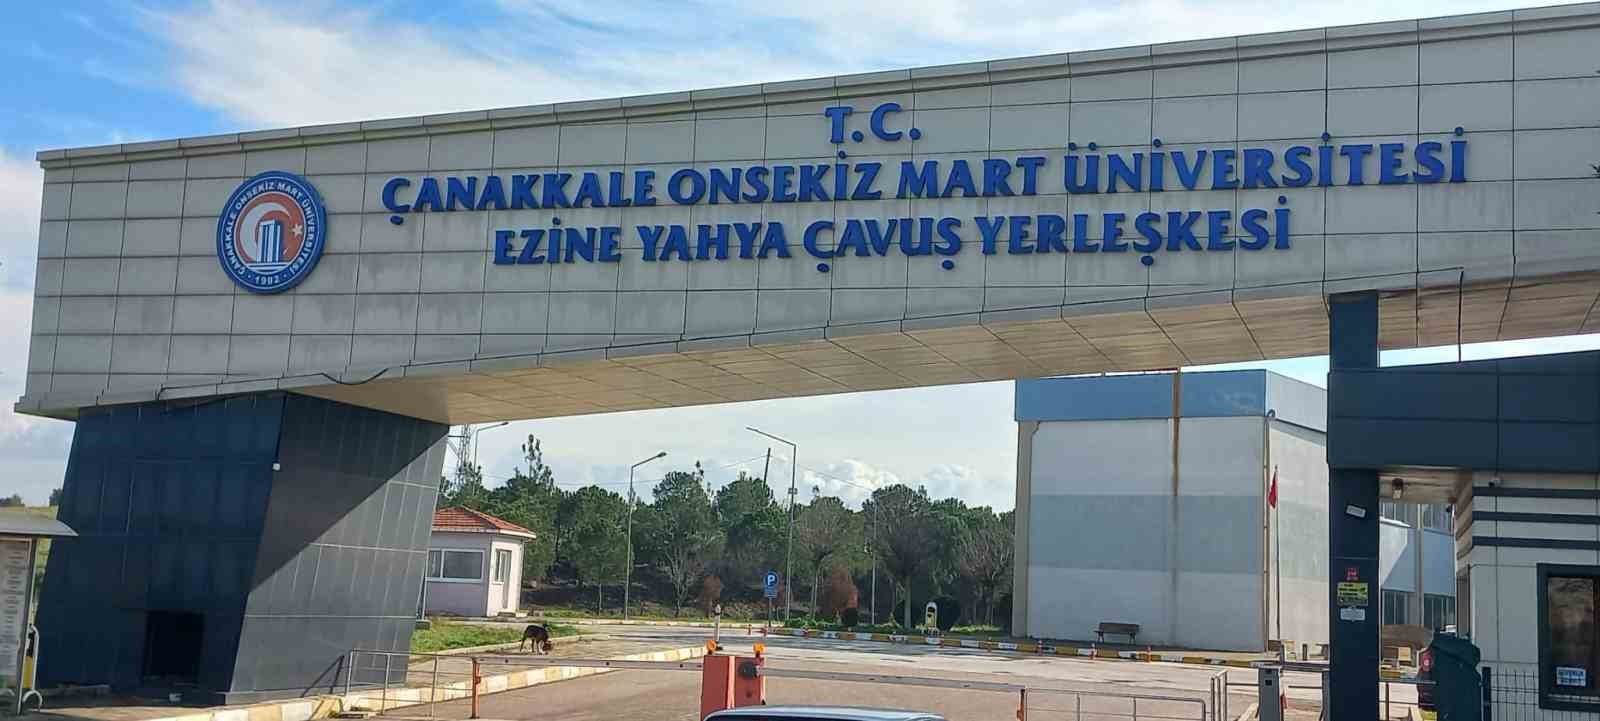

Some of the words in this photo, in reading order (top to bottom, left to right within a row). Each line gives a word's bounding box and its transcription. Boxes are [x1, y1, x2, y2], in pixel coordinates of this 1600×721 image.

[825, 102, 921, 145] T.C.
[277, 182, 304, 201] MART
[383, 170, 657, 225] ÇANAKKALE
[668, 150, 882, 207] ONSEKİZ
[897, 156, 1047, 200] MART
[1065, 127, 1468, 195] ÜNİVERSİTESİ
[494, 217, 622, 265] EZİNE
[637, 223, 790, 262] YAHYA
[803, 217, 962, 271] ÇAVUŞ
[975, 195, 1291, 267] YERLEŞKESİ
